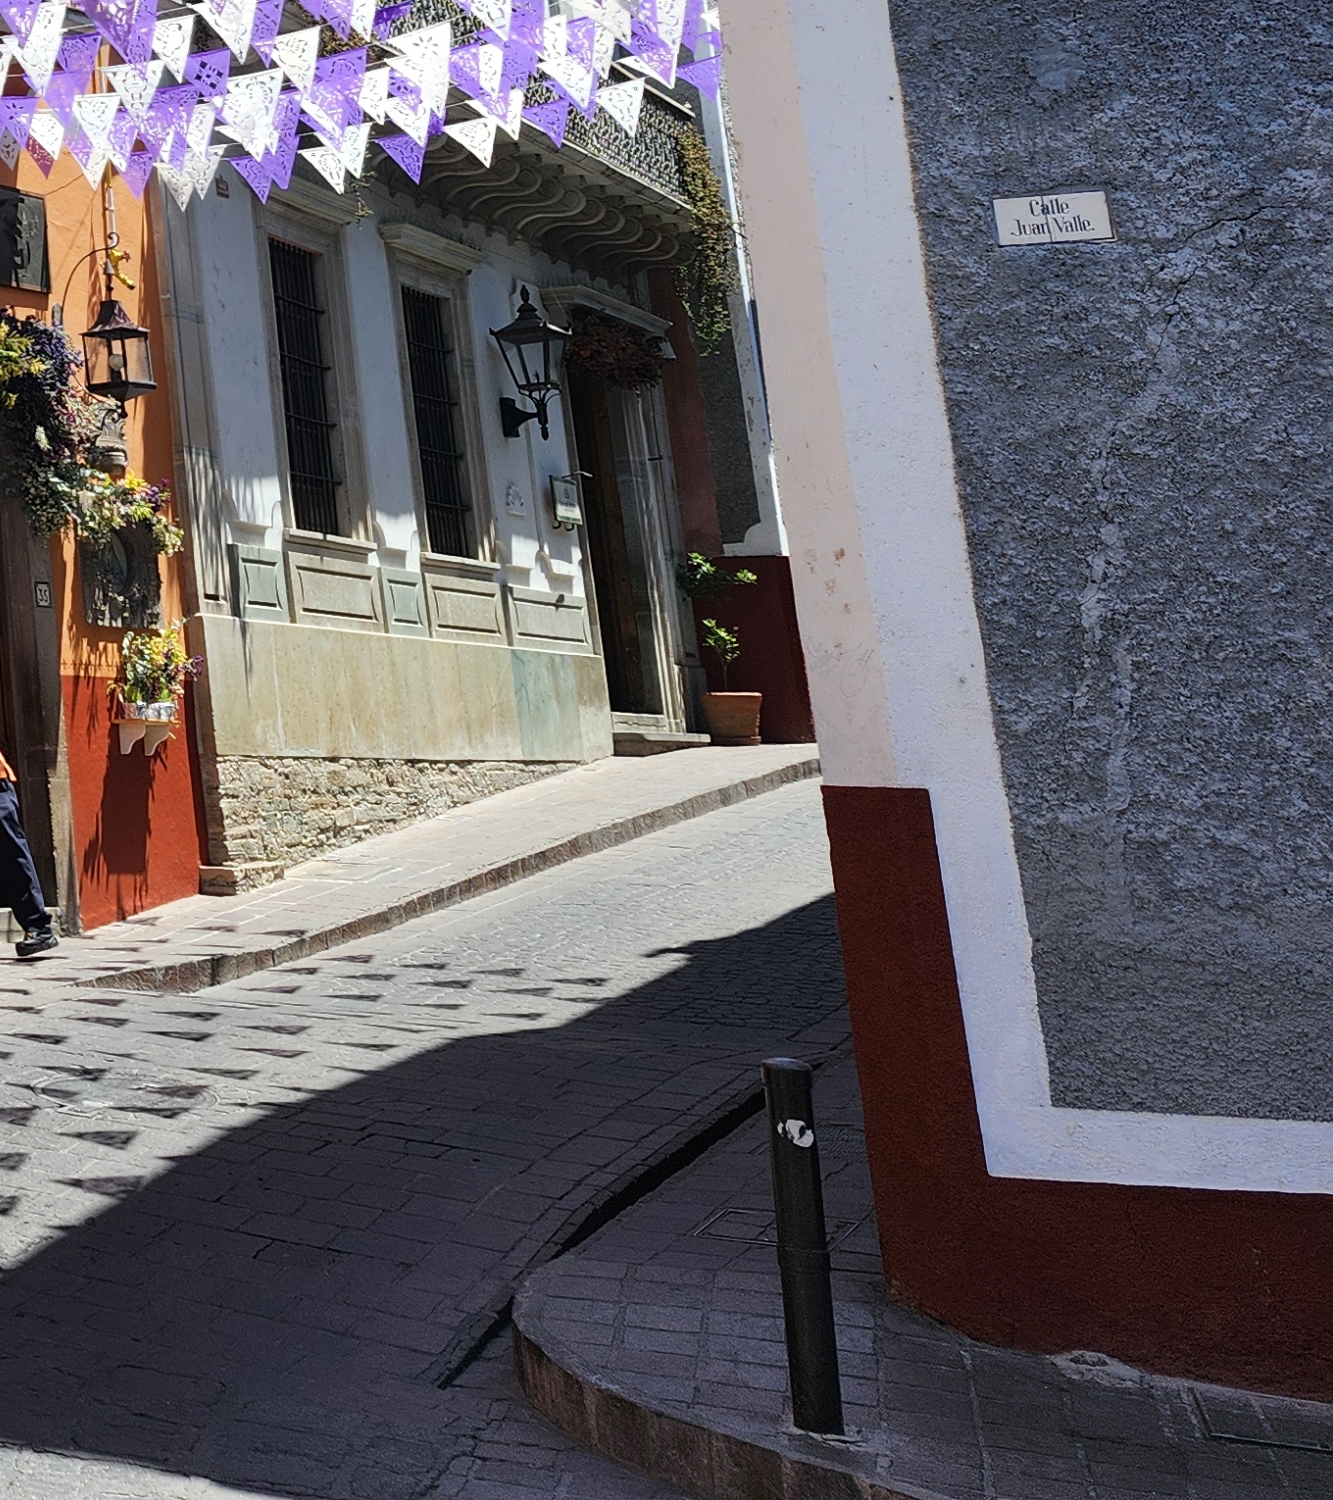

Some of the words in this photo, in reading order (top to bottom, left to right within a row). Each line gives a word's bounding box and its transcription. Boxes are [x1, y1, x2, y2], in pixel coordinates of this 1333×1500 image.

[1029, 198, 1070, 217] Calle
[1010, 218, 1050, 237] Juan
[38, 587, 48, 603] 35
